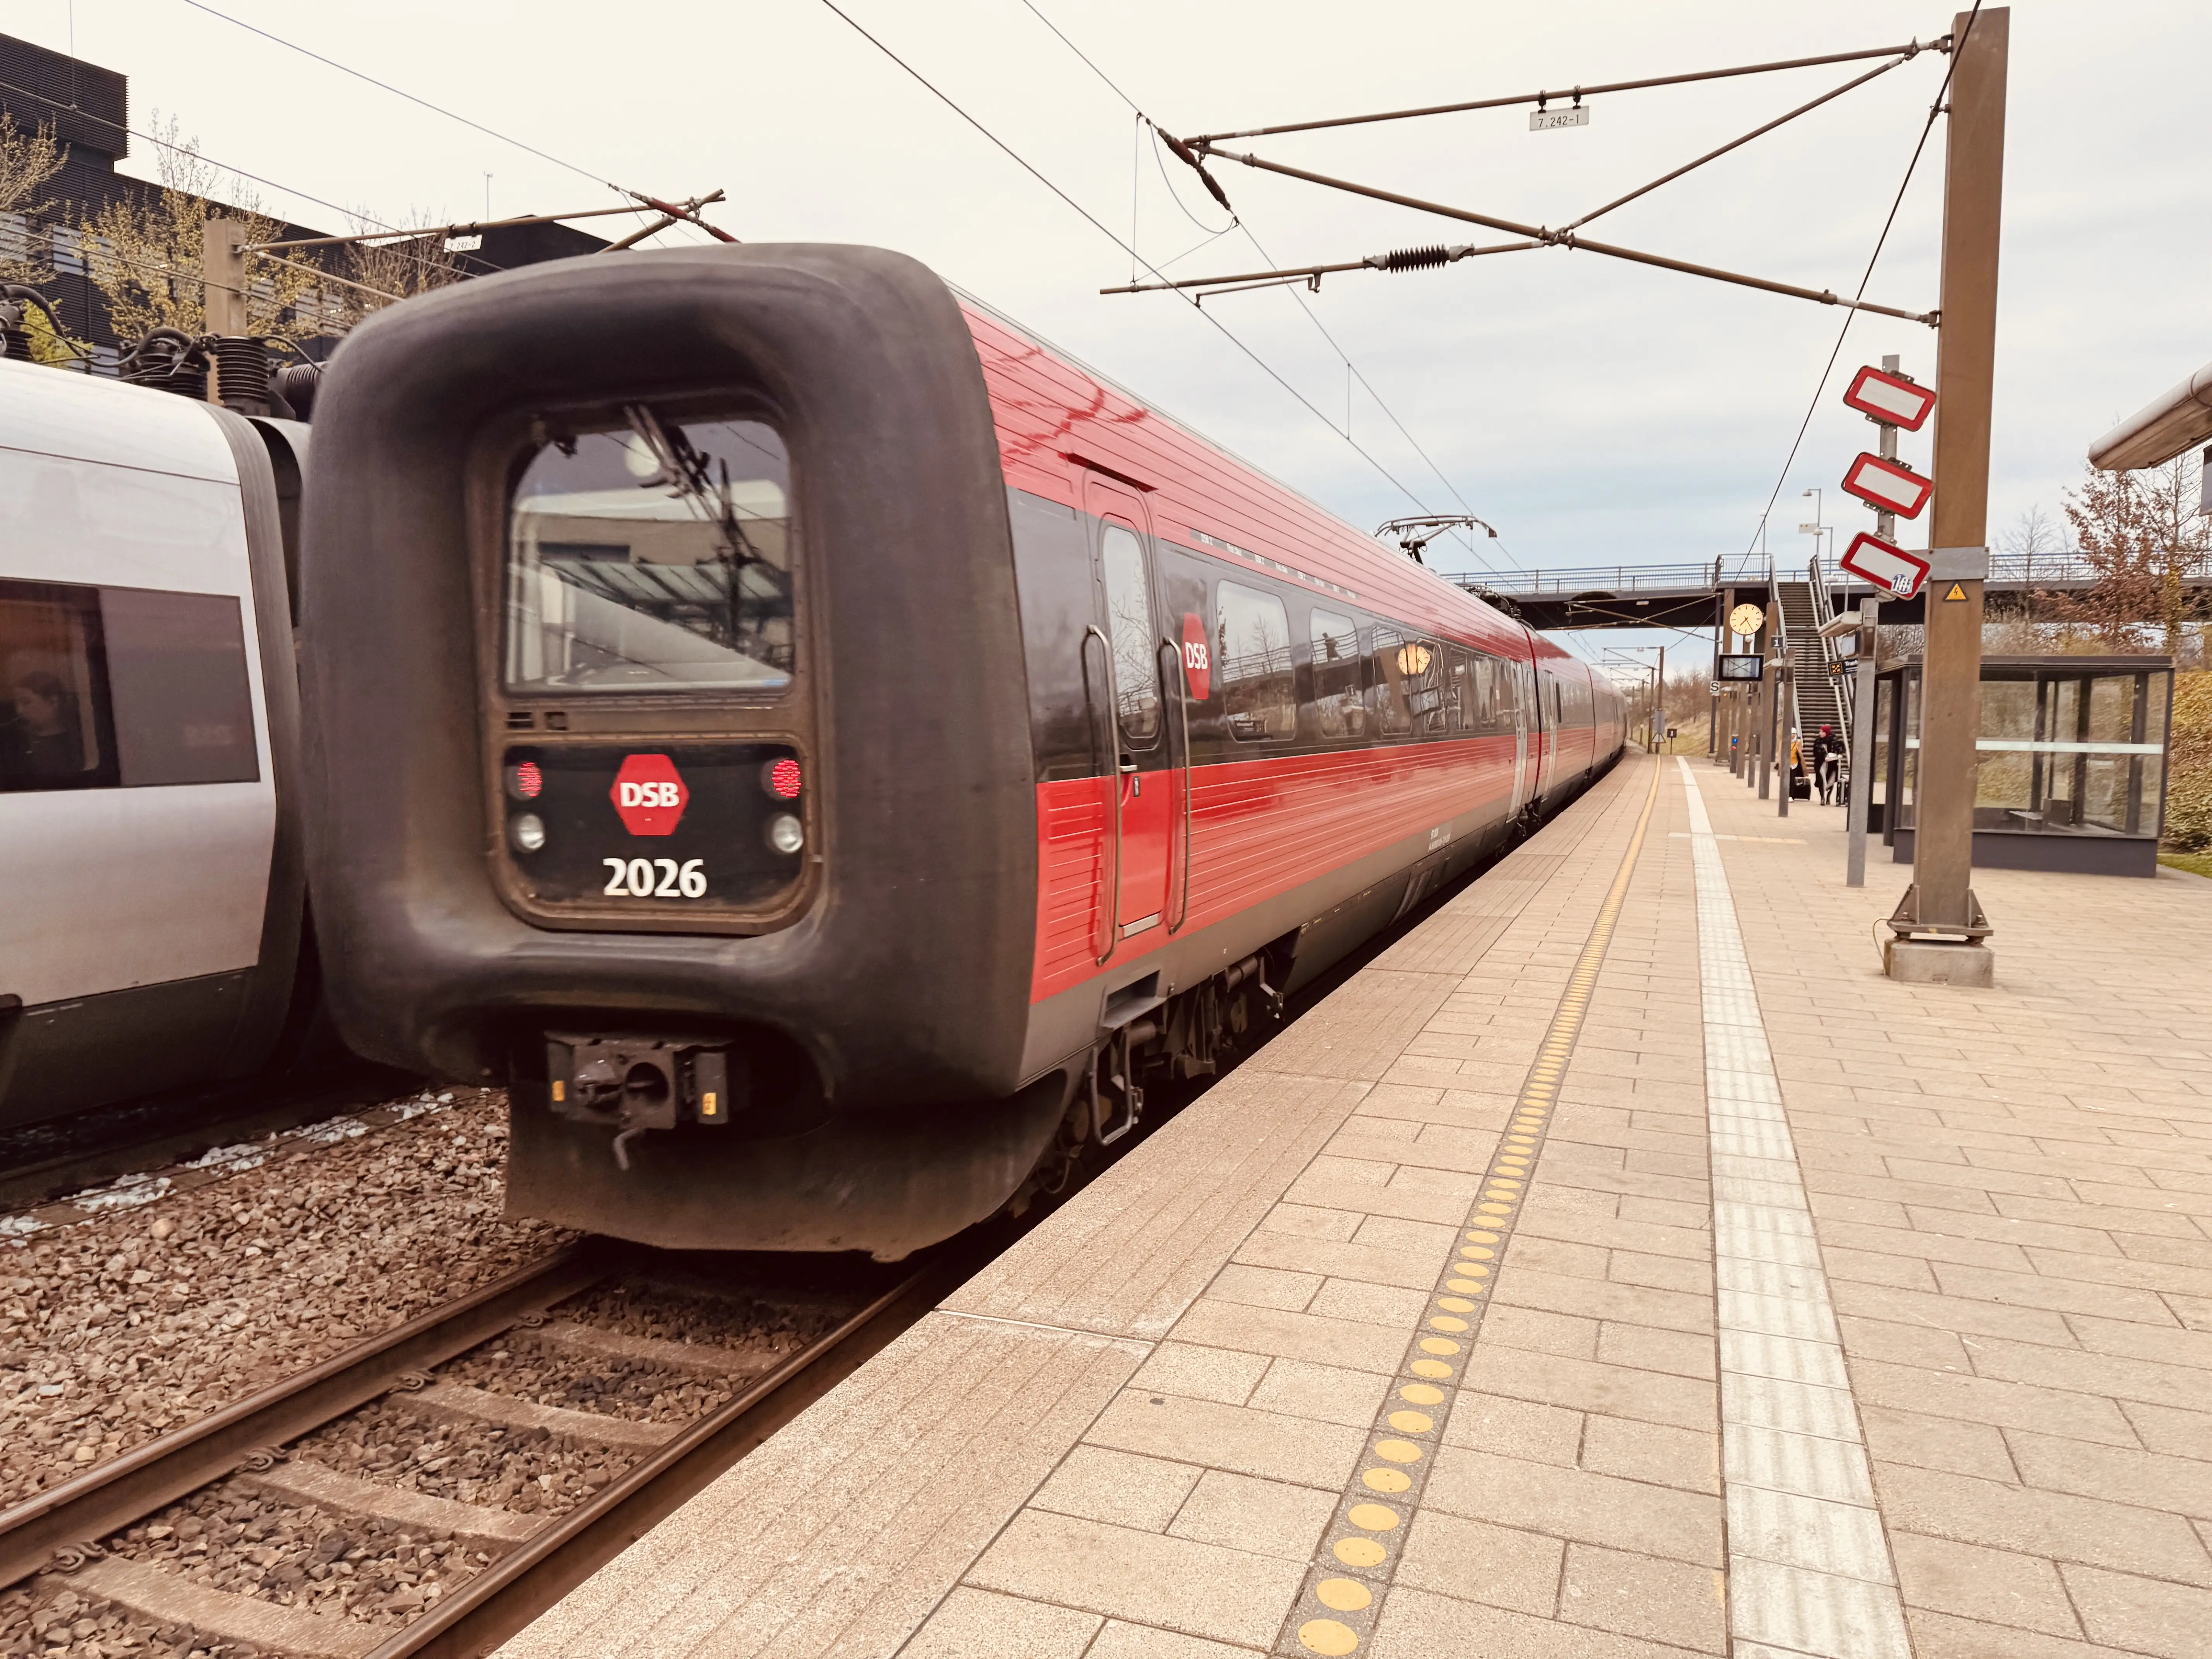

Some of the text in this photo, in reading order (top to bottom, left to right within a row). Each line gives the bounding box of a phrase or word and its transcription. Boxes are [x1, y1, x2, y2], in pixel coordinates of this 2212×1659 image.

[1538, 114, 1579, 128] 7.242-1
[1185, 642, 1208, 669] DSB
[1711, 682, 1719, 692] S
[620, 781, 680, 807] DSB
[603, 857, 708, 898] 2026
